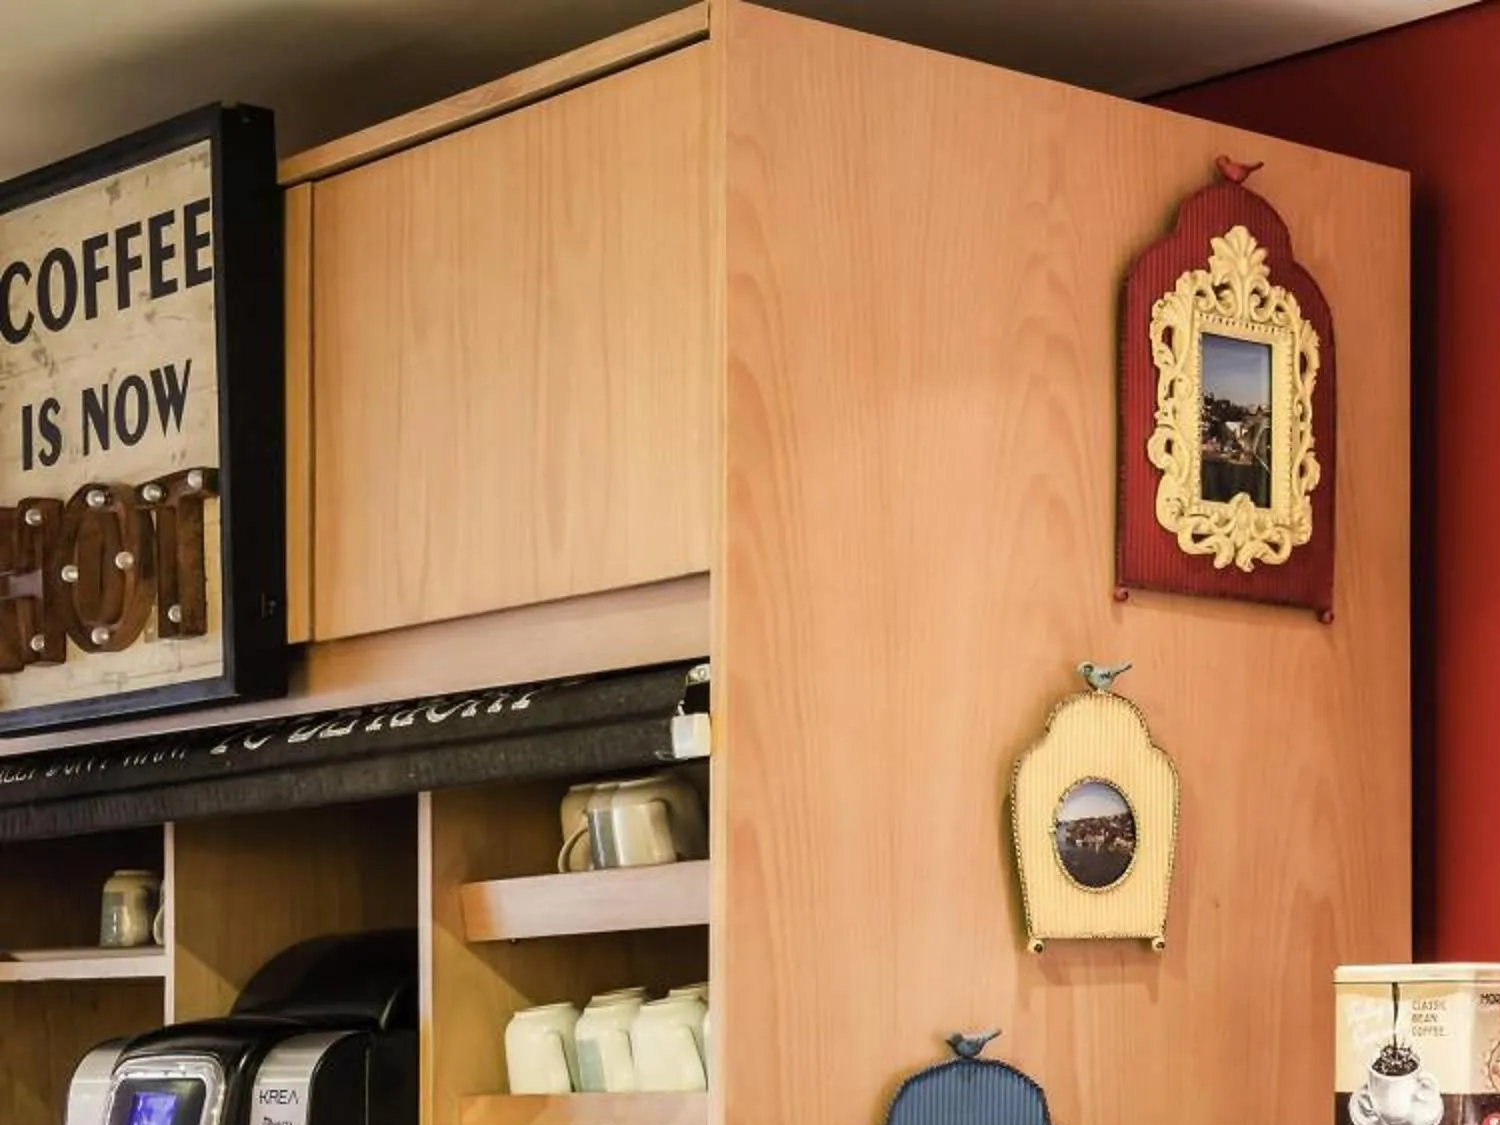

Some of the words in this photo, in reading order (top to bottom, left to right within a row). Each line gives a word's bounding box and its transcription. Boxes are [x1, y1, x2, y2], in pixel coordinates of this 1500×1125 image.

[0, 196, 213, 345] COFFEE
[21, 396, 63, 471] IS
[81, 358, 192, 457] NOW
